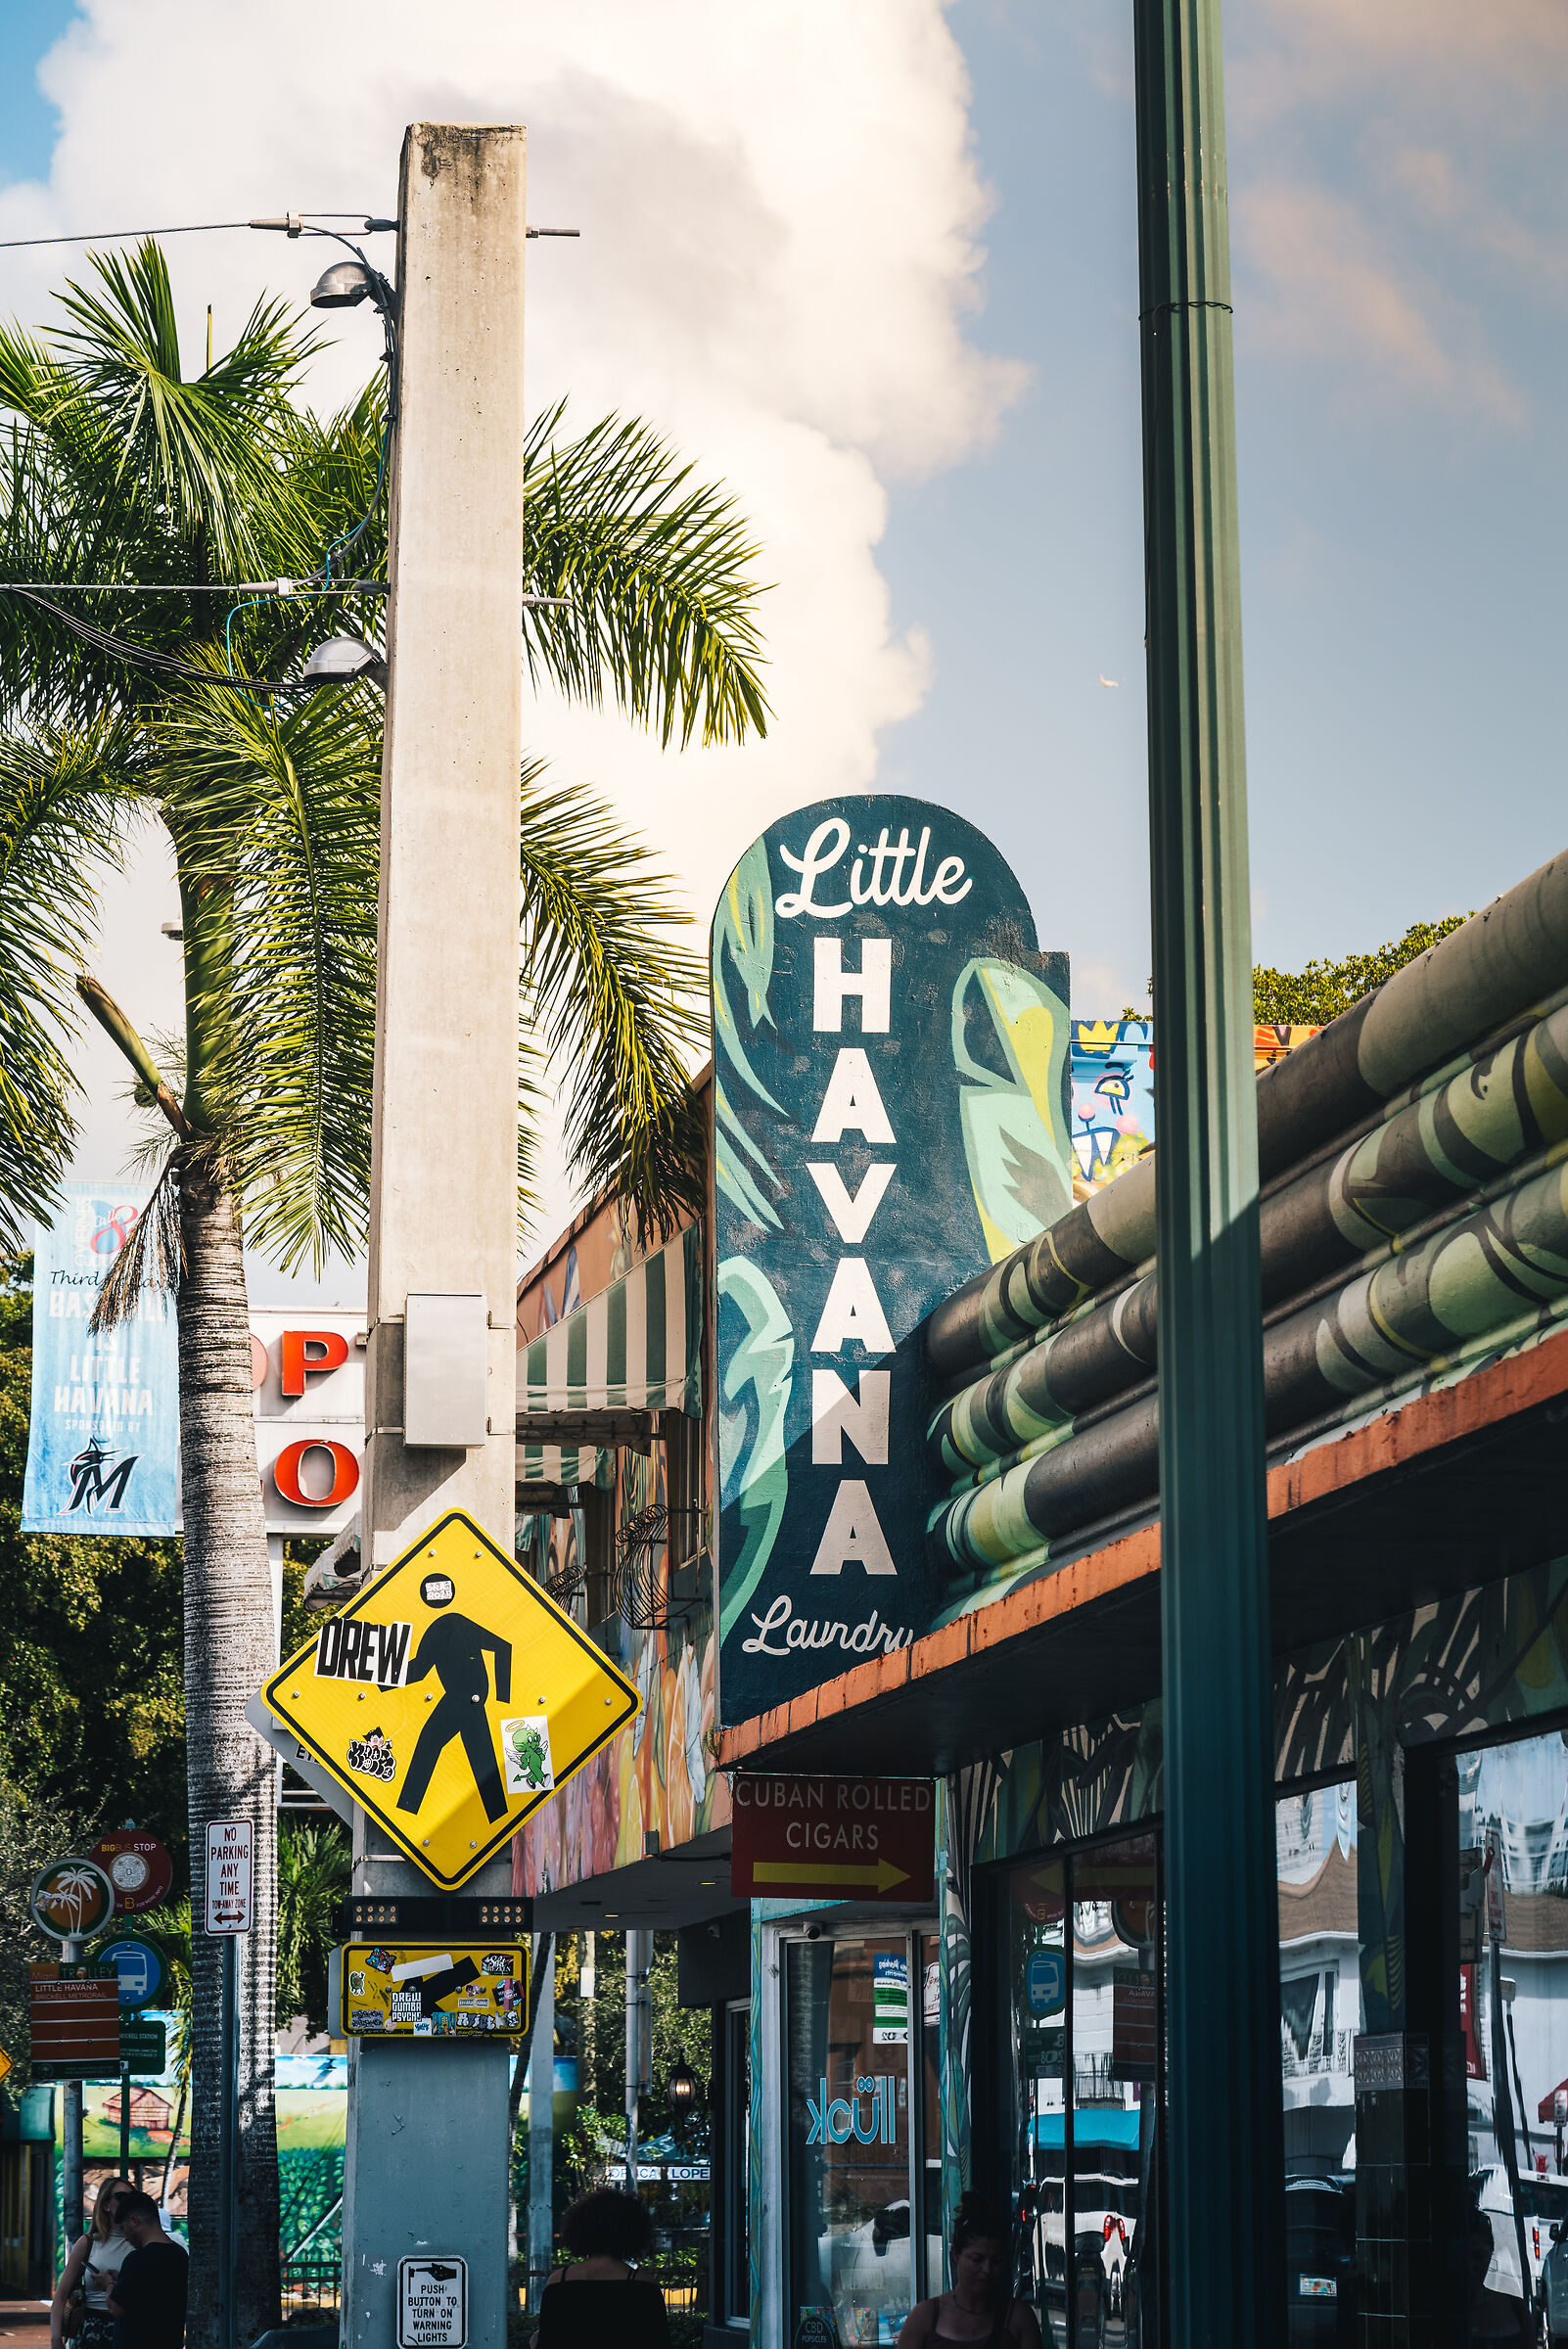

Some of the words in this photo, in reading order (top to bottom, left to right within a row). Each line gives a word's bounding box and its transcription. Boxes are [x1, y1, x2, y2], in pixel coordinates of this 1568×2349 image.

[775, 817, 972, 918] Little
[806, 937, 898, 1575] HAVANA
[51, 1270, 101, 1286] Third
[70, 1355, 141, 1384] LITTLE
[54, 1386, 153, 1415] HAVANA
[742, 1594, 913, 1656] Laundry
[316, 1616, 411, 1686] DREW
[735, 1780, 825, 1809] CUBAN
[837, 1783, 931, 1812] ROLLED
[224, 1827, 237, 1841] NO
[786, 1821, 879, 1851] CIGARS
[133, 1843, 157, 1852] STOP
[210, 1845, 249, 1861] PARKING
[220, 1863, 239, 1878] ANY
[219, 1880, 240, 1896] TIME
[234, 1898, 247, 1909] ZONE
[35, 1984, 63, 1993] LITTLE
[64, 1983, 98, 1992] HAVANA
[392, 1992, 422, 2002] DREW
[421, 2284, 444, 2294] PUSH
[408, 2297, 440, 2306] BUTTON
[446, 2297, 457, 2306] TO
[412, 2309, 435, 2318] TURN
[440, 2309, 452, 2318] ON
[413, 2321, 452, 2330] WARNING
[417, 2332, 447, 2342] LIGHTS
